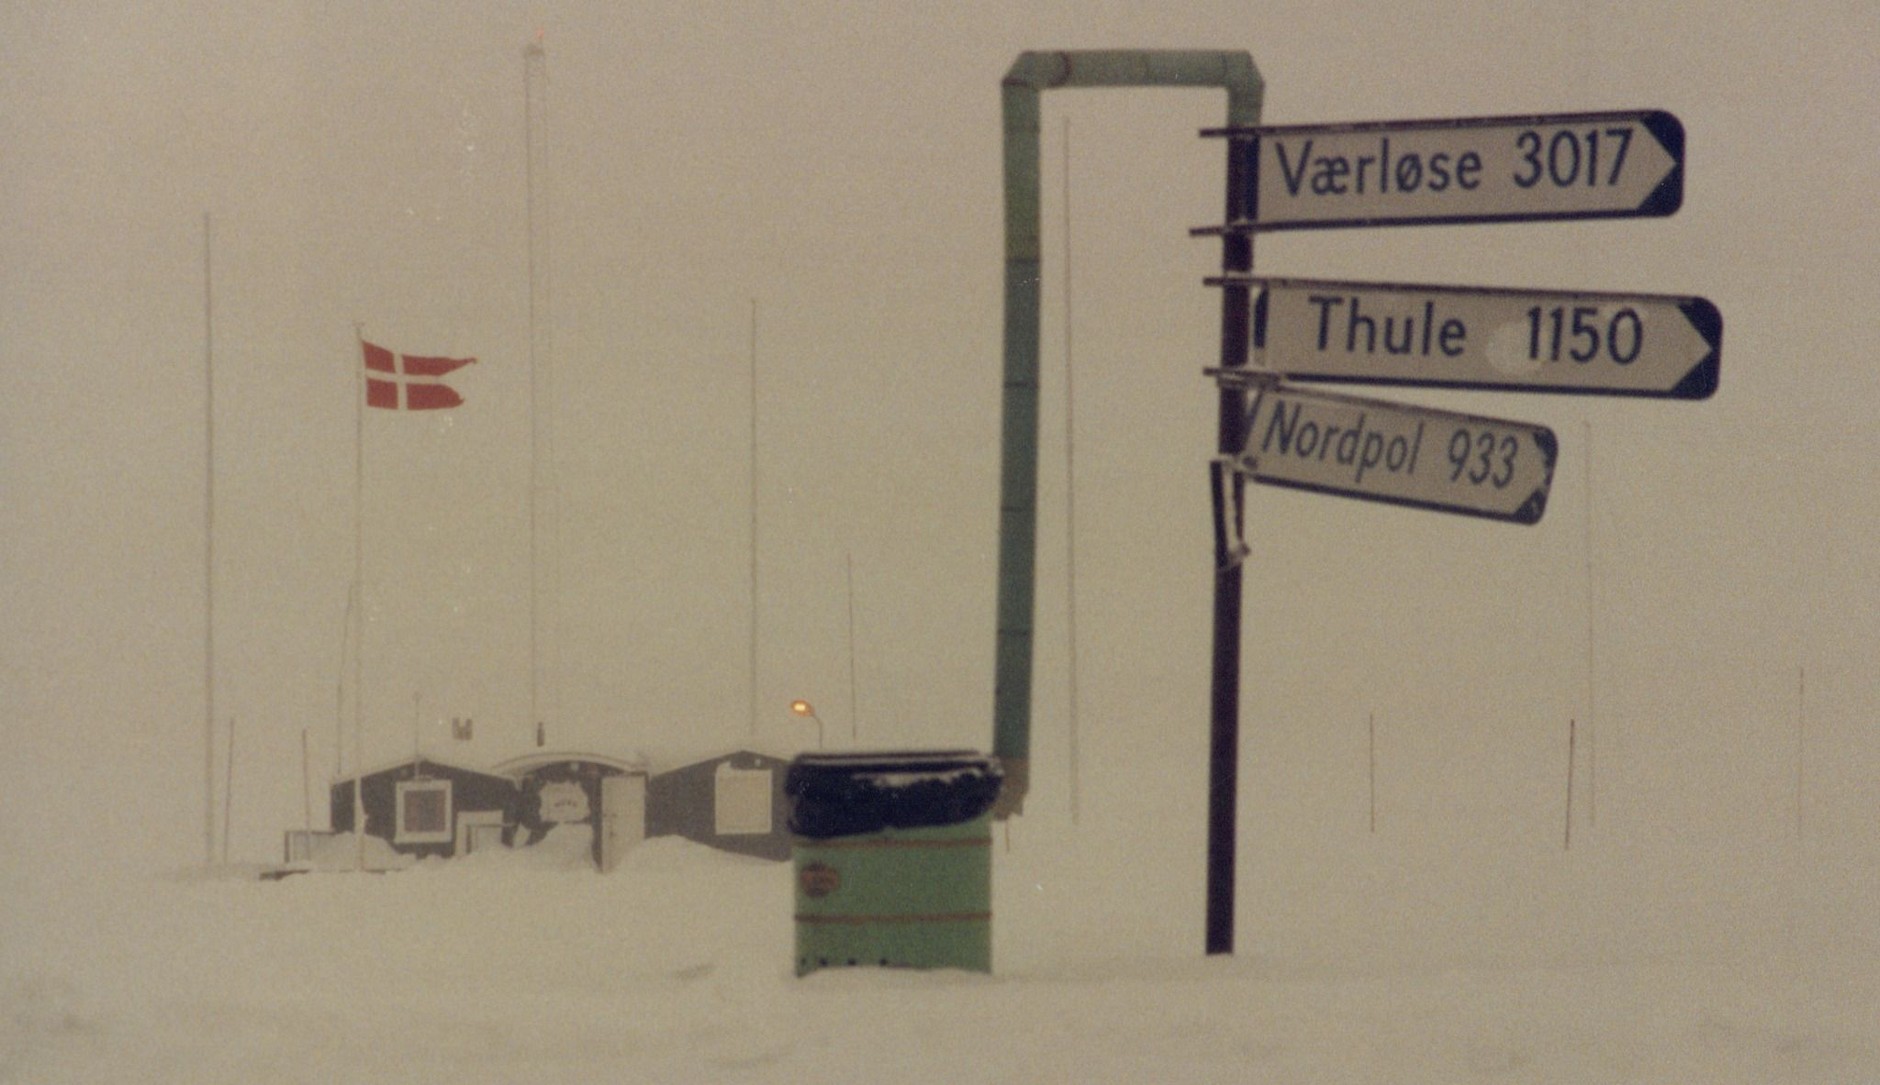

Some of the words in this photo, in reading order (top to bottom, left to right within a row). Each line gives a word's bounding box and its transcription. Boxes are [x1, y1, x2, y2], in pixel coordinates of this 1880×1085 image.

[1276, 137, 1483, 197] Værløse
[1513, 127, 1634, 188] 3017
[1308, 296, 1467, 357] Thule
[1527, 305, 1643, 365] 1150
[1261, 400, 1424, 483] Nordpol
[1447, 428, 1518, 488] 933
